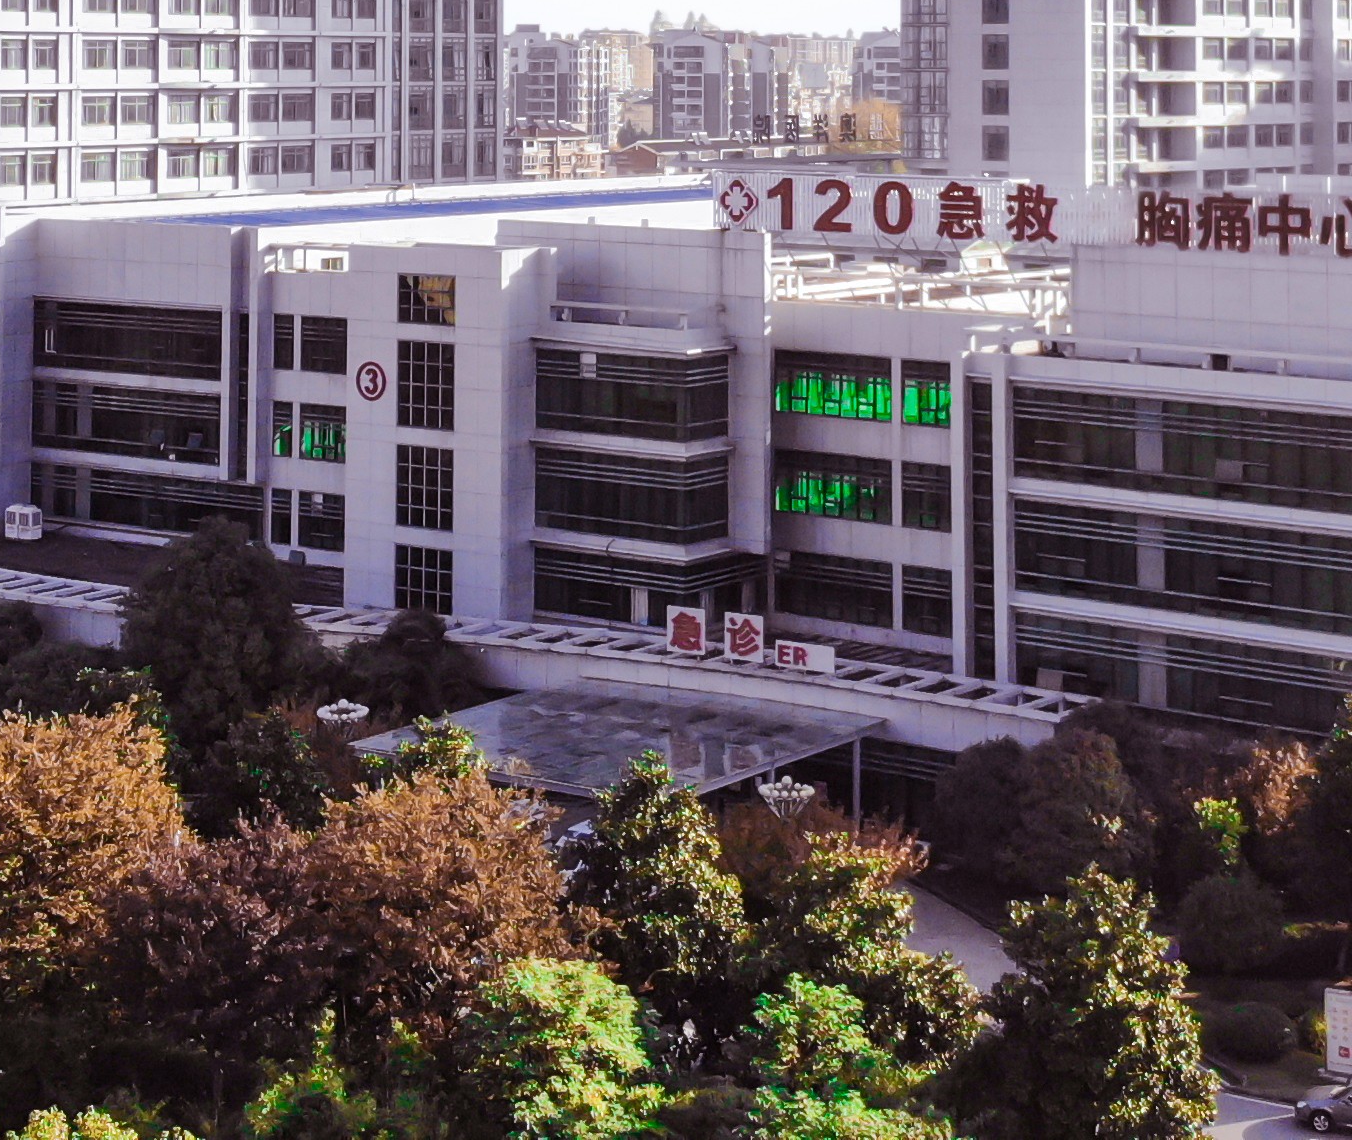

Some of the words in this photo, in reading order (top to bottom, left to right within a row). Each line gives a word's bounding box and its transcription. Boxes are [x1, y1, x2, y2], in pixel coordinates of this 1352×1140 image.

[766, 177, 1059, 245] 120急救
[669, 611, 761, 656] 急诊
[777, 644, 809, 667] ER
